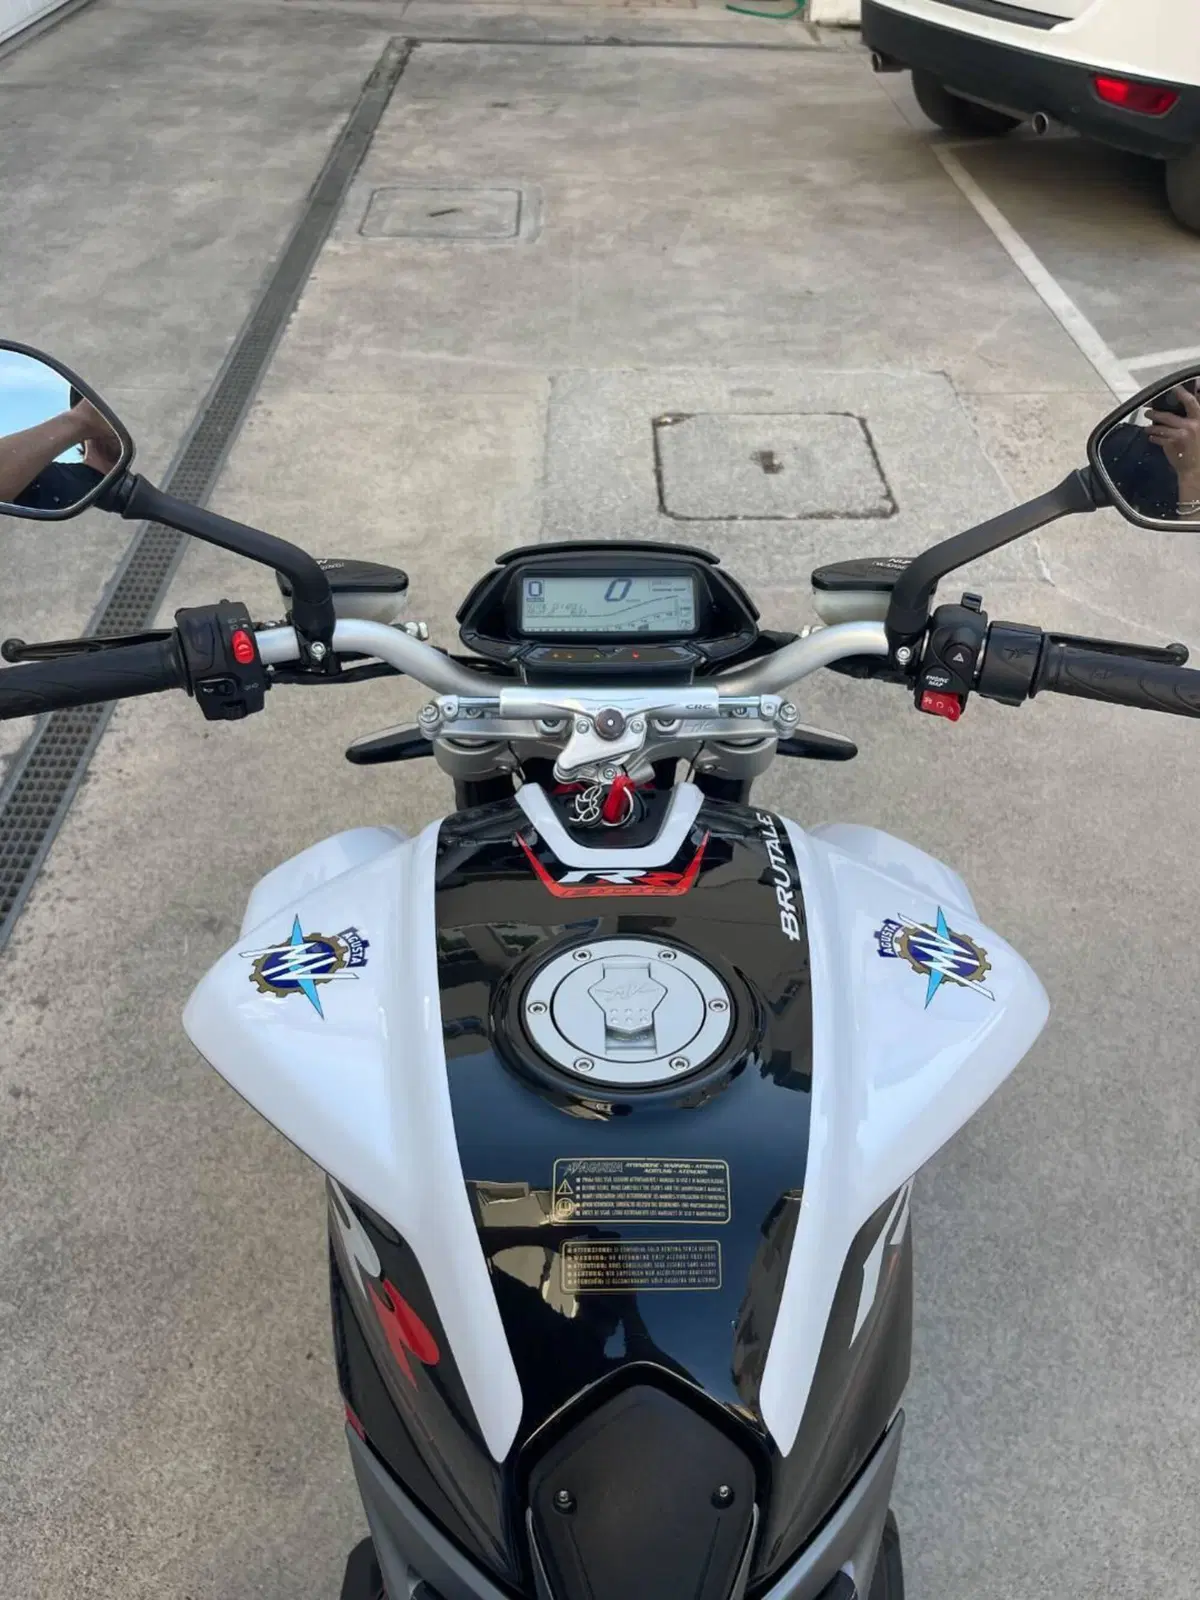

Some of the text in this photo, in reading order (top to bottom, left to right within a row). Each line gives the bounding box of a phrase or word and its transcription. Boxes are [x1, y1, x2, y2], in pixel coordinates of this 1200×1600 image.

[604, 578, 632, 602] 0
[755, 812, 801, 941] BRUTALE
[342, 931, 364, 964] AGUSTA
[881, 921, 900, 955] AGUSTA
